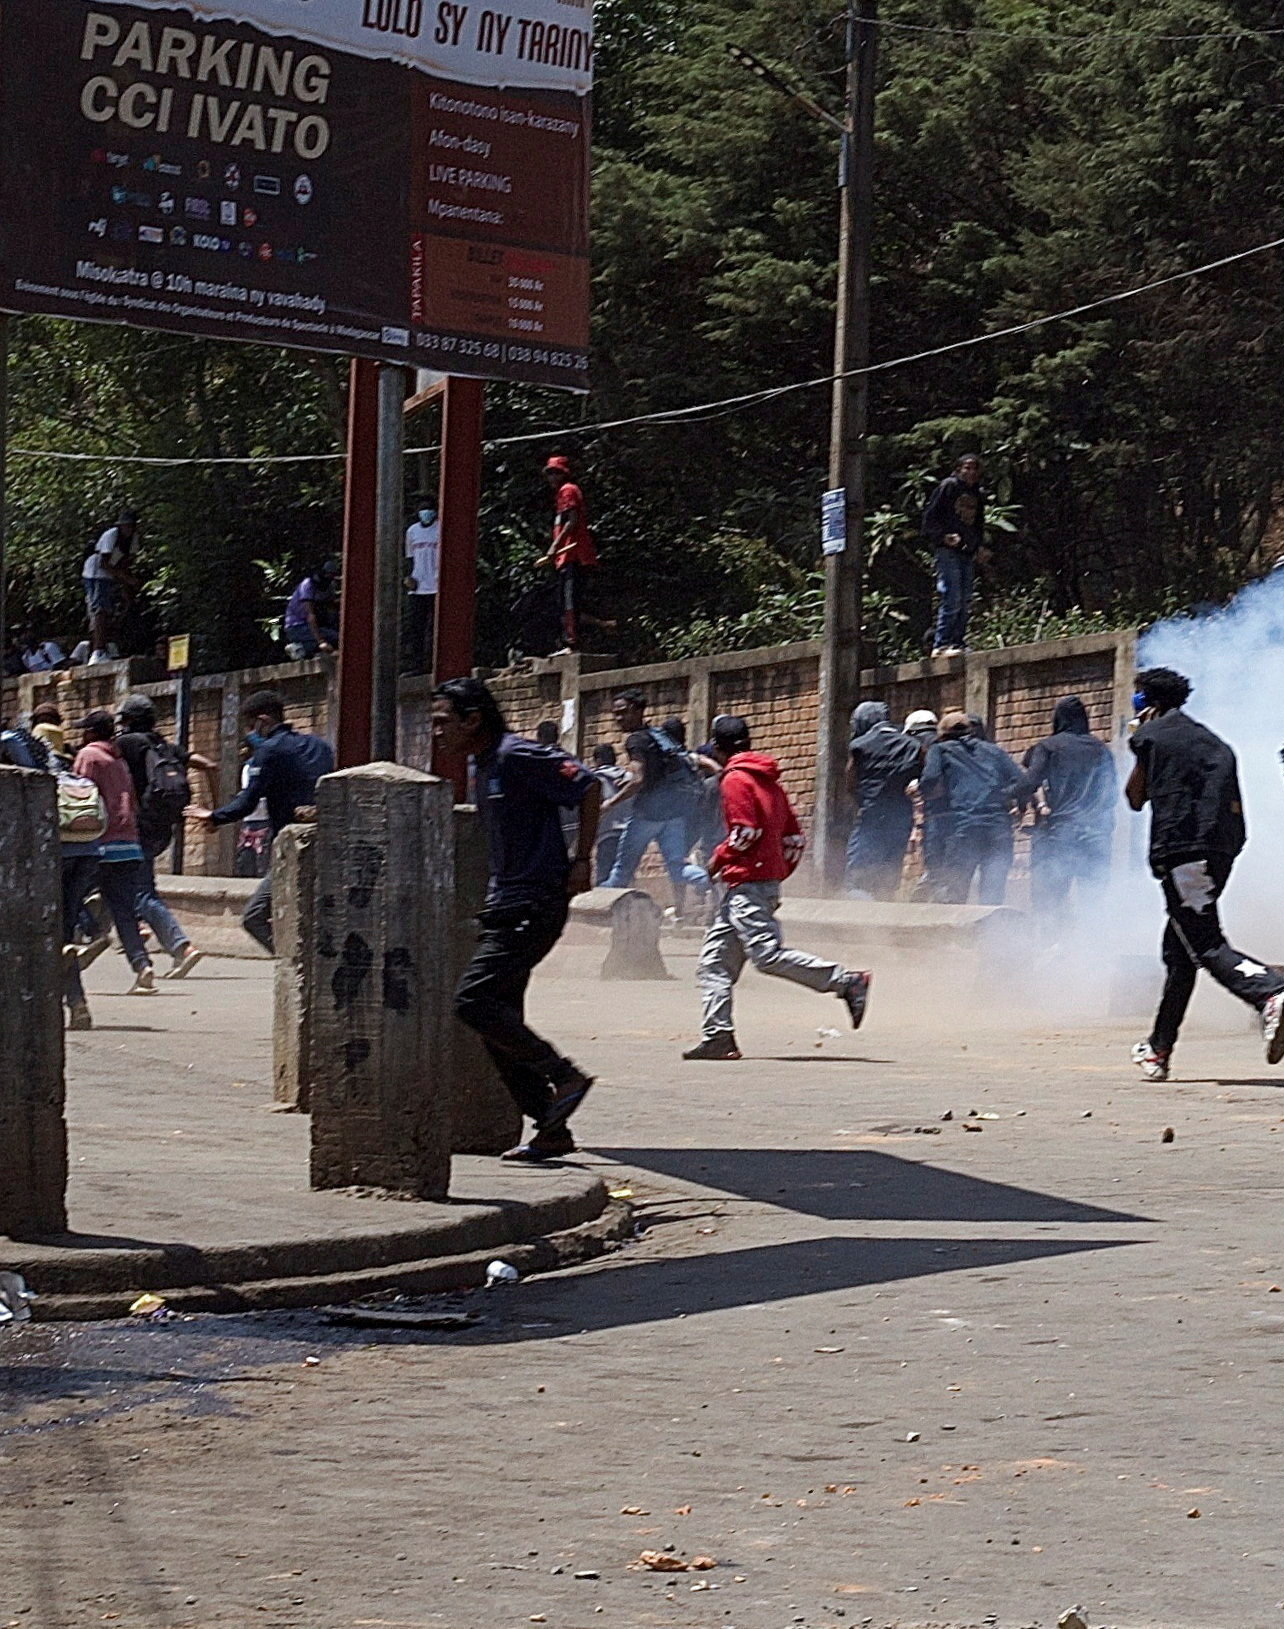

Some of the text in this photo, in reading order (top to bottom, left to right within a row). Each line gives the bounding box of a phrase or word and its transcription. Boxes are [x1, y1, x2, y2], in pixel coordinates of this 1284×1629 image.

[80, 12, 332, 104] PARKING
[434, 1, 468, 46] SY
[476, 10, 513, 55] NY
[517, 18, 592, 72] TARINY
[80, 76, 330, 160] CCI IVATO
[429, 164, 513, 194] LIVE PARKING
[150, 270, 165, 289] @
[166, 273, 193, 294] 10h
[250, 289, 266, 307] ny
[412, 240, 422, 318] TAPAKILA
